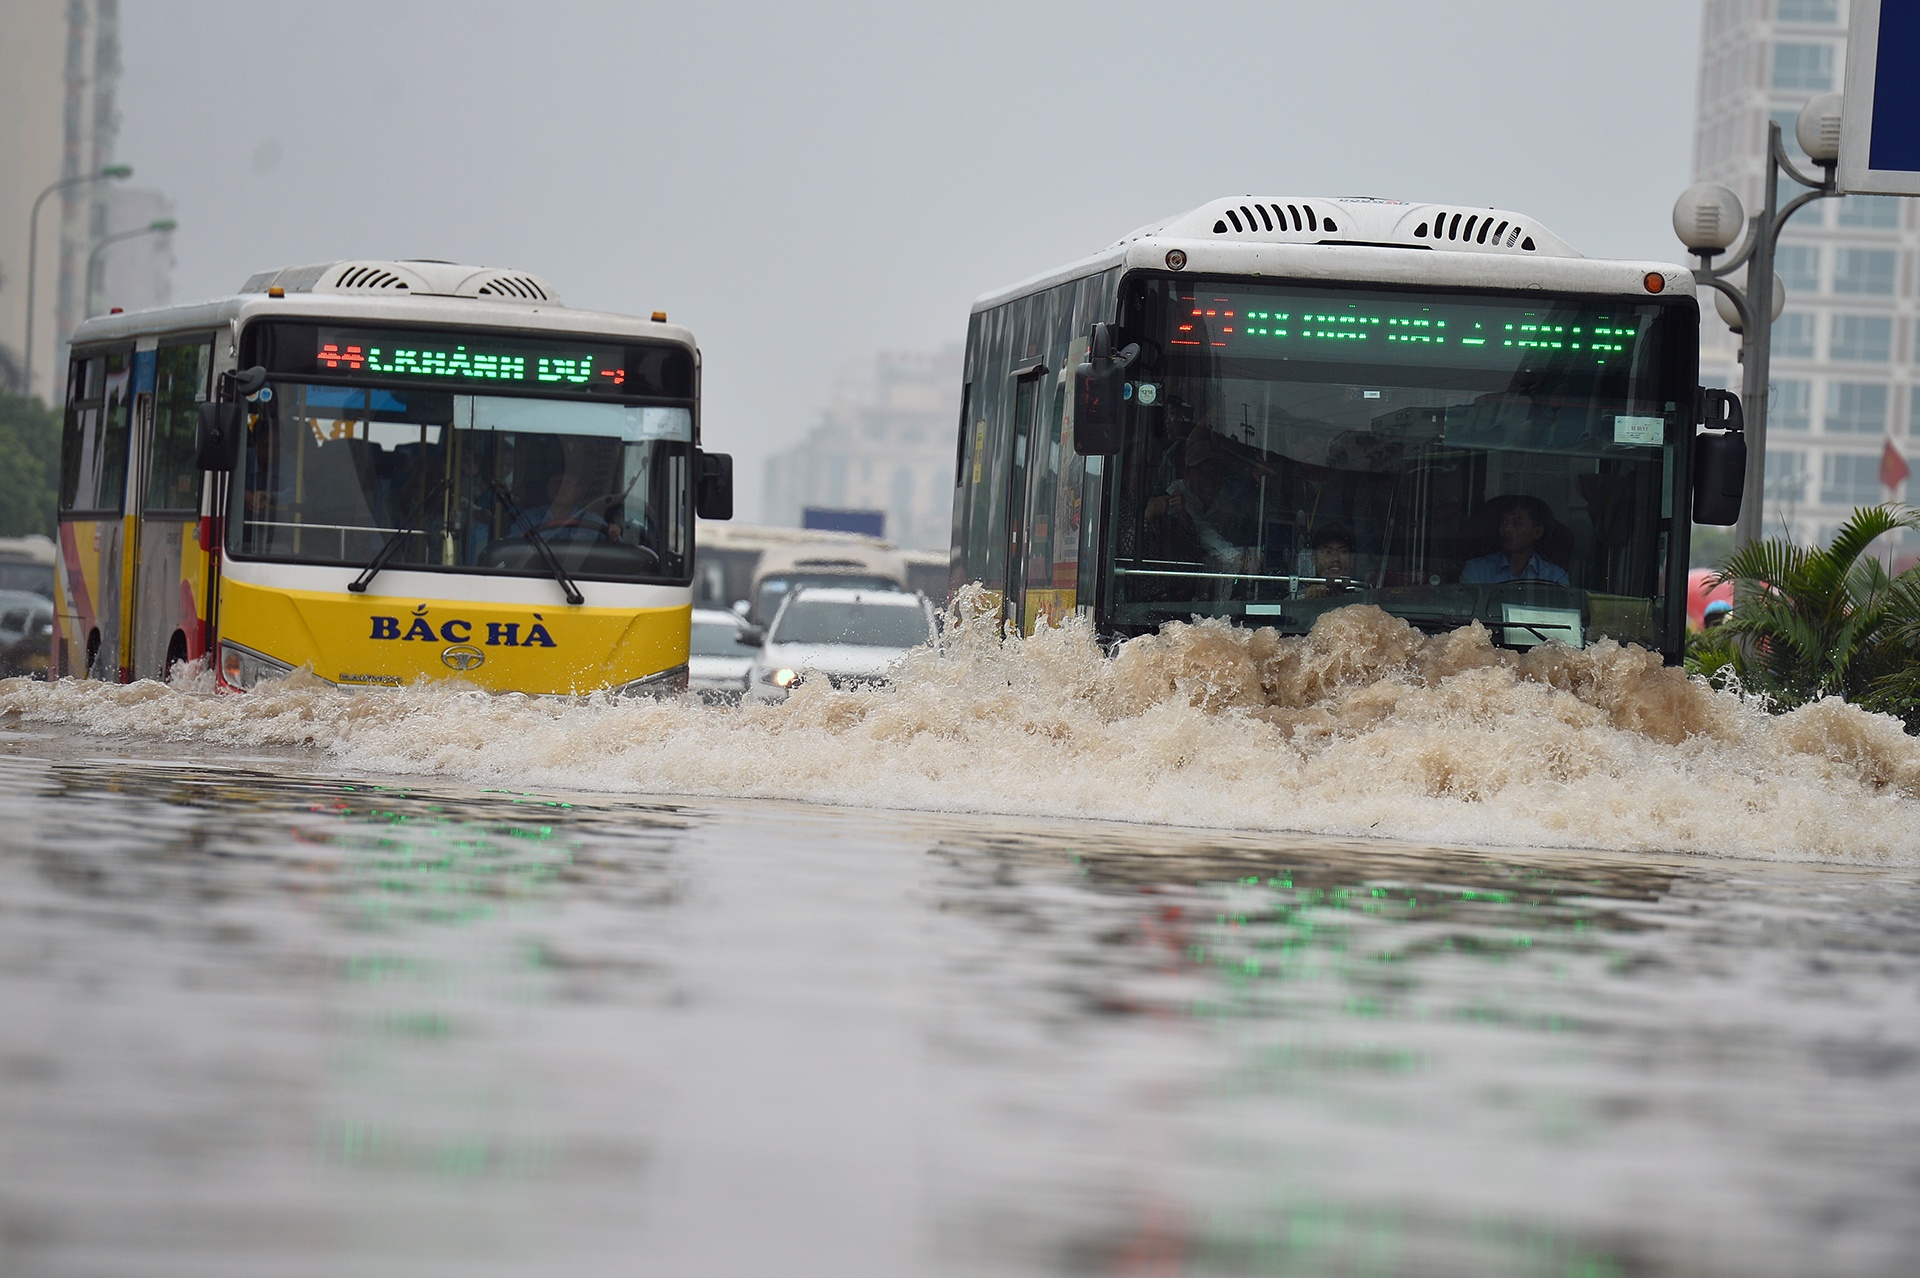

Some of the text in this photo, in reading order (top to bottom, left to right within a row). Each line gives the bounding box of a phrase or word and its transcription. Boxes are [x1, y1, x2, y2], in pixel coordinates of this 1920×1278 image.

[317, 344, 365, 369] 44
[369, 603, 558, 648] BẮC HÀ
